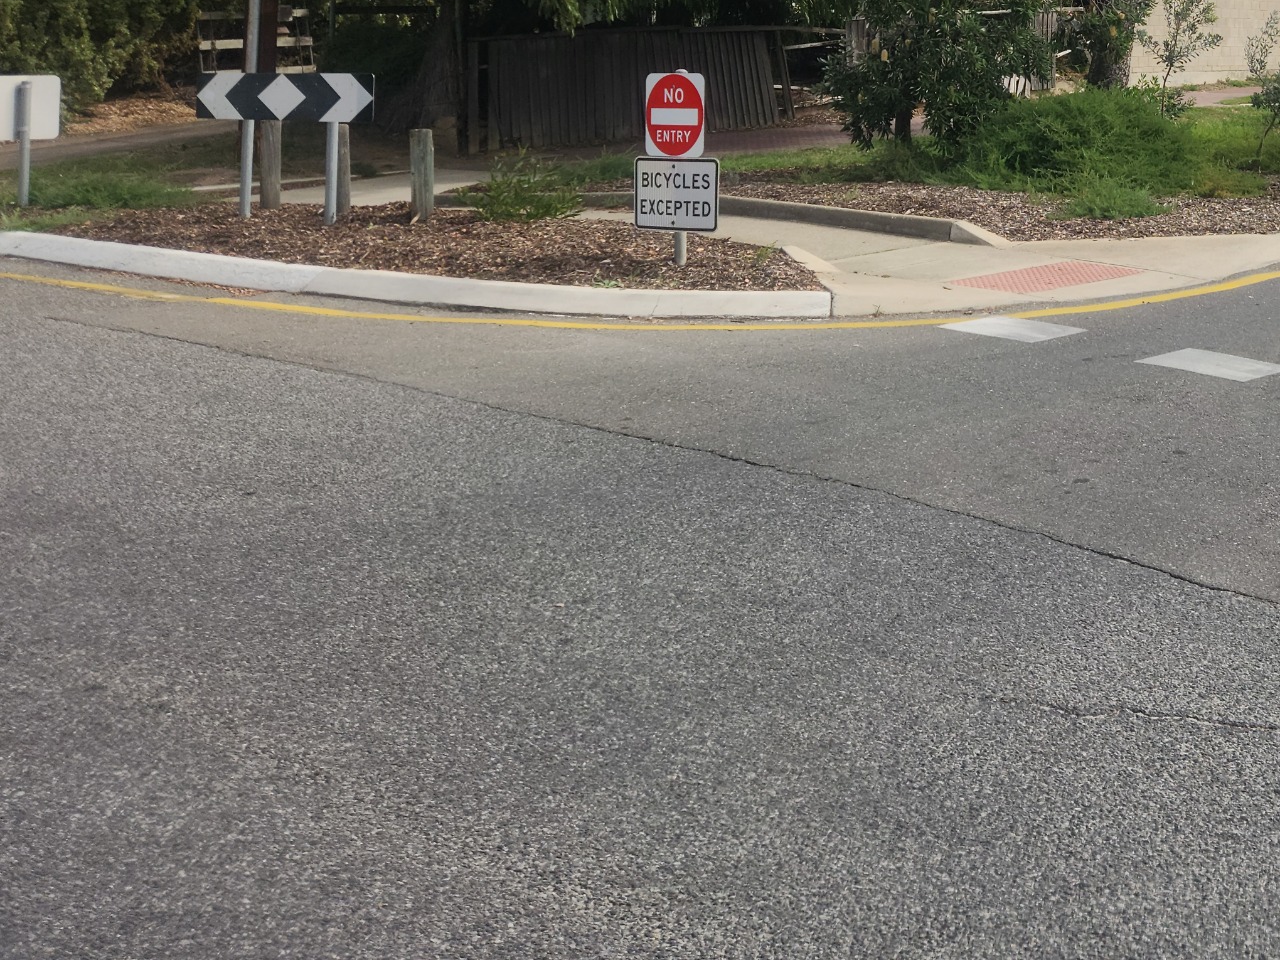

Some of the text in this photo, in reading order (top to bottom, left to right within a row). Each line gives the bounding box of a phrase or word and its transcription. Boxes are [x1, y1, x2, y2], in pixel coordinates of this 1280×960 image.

[663, 87, 684, 103] NO
[656, 129, 692, 143] ENTRY
[641, 171, 711, 190] BICYCLES
[640, 198, 711, 218] EXCEPTED
